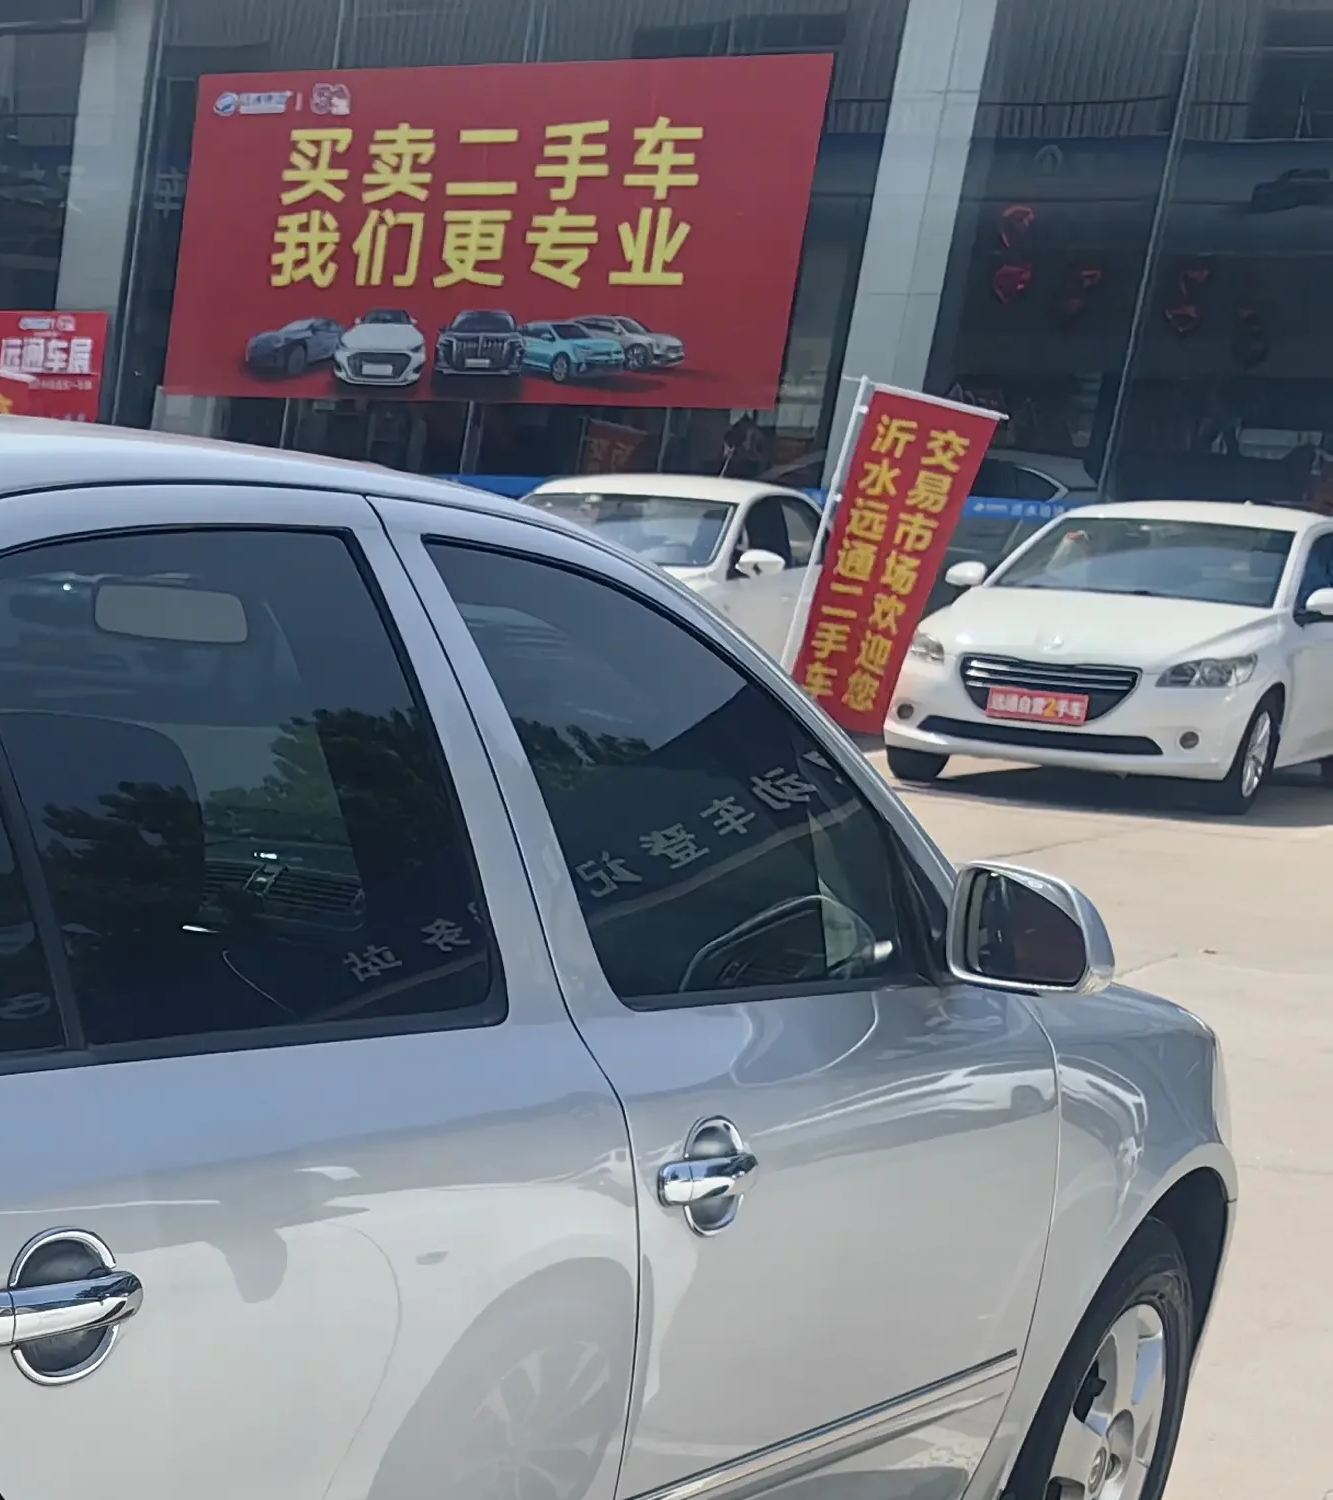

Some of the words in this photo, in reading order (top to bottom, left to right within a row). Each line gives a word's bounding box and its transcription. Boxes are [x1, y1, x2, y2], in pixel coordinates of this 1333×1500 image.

[270, 206, 691, 289] 我们更专业
[280, 116, 704, 206] 买卖二手车
[801, 414, 919, 699] 沂水远通二手车
[841, 429, 971, 713] 交易市场欢迎您
